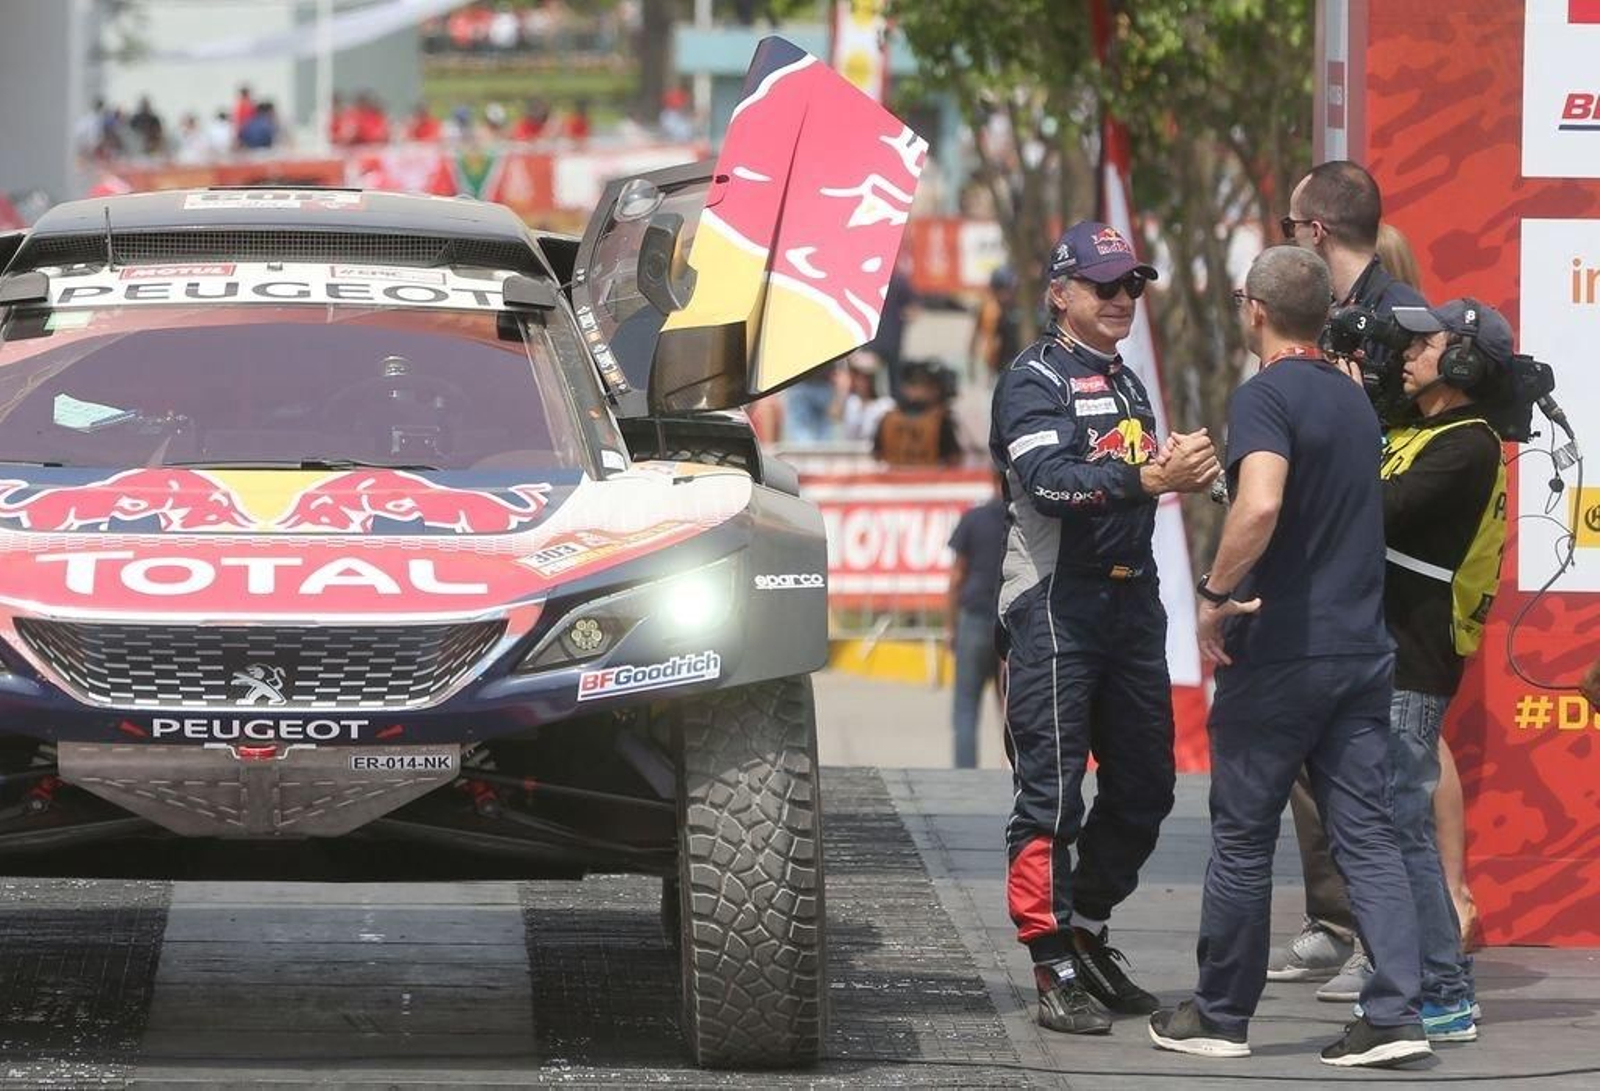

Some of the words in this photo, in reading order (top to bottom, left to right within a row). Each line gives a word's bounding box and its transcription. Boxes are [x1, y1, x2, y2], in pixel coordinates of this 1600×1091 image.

[133, 265, 226, 277] MOTUL
[57, 282, 504, 306] PEUGEOT
[1357, 316, 1367, 329] 3
[35, 551, 487, 595] TOTAL
[581, 653, 720, 691] BFGoodrich
[1515, 695, 1600, 729] #D
[152, 719, 369, 739] PEUGEOT
[353, 756, 450, 769] ER-014-NK
